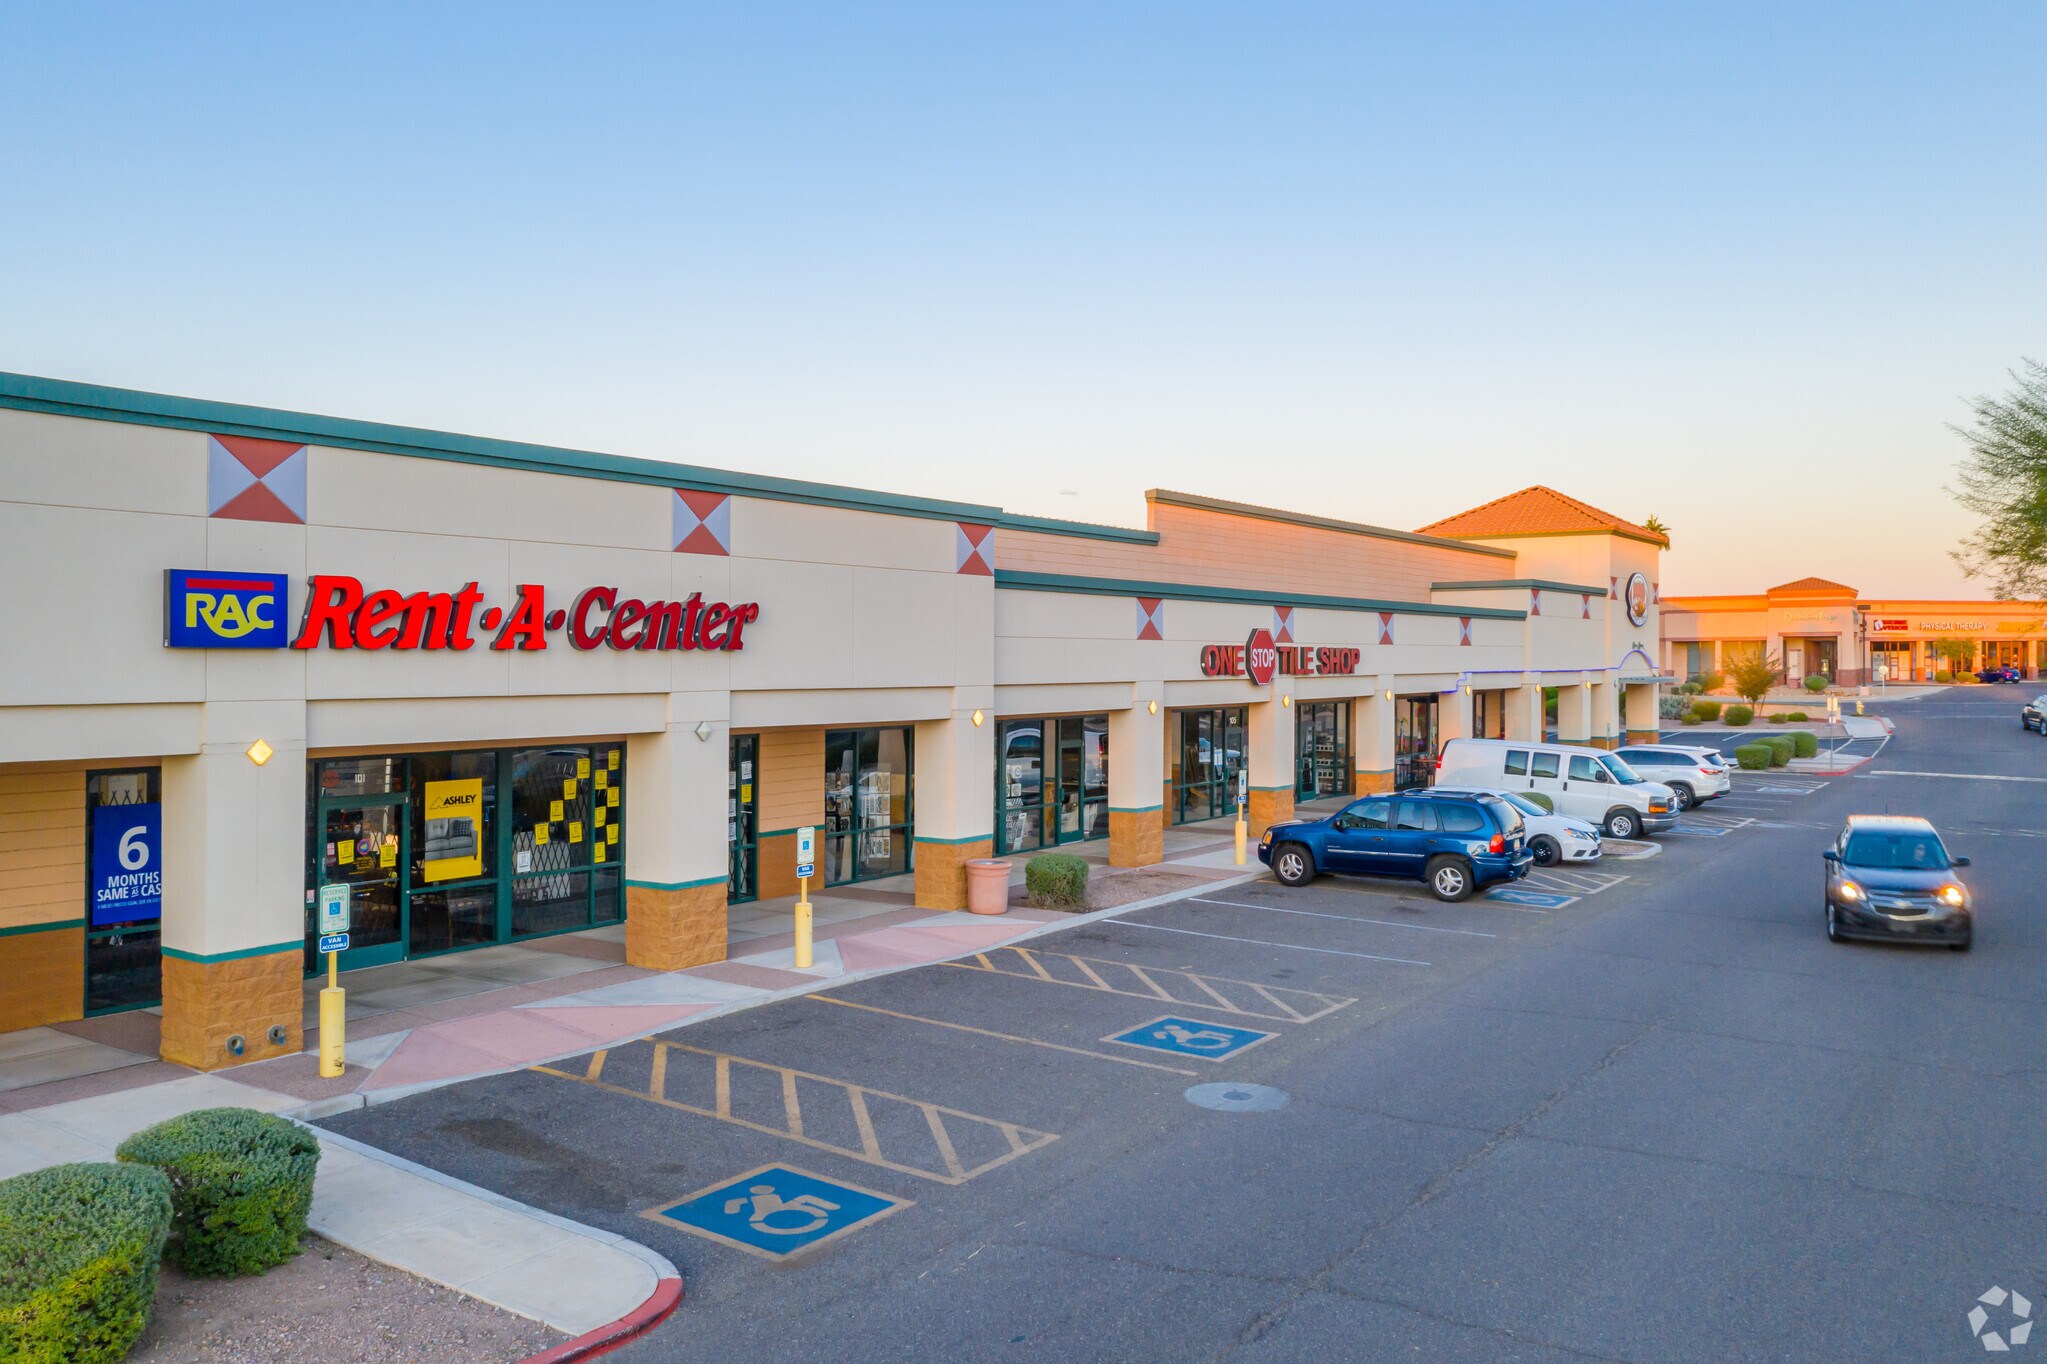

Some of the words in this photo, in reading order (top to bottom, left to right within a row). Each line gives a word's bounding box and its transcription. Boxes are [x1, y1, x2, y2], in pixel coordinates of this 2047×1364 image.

[186, 593, 274, 639] RAC
[1920, 622, 1954, 631] PHYSICAL
[1956, 622, 1987, 631] THERAPY
[1202, 645, 1245, 676] ONE
[1252, 648, 1275, 668] STOP
[1277, 646, 1314, 675] TILE
[1317, 647, 1361, 675] SHOP
[1229, 716, 1237, 725] 105
[354, 773, 366, 783] 101
[443, 794, 477, 806] ASHLEY
[118, 825, 149, 871] 6
[108, 871, 159, 888] MONTHS
[97, 887, 129, 902] SAME
[131, 886, 139, 897] AS
[141, 883, 162, 895] CAS
[323, 887, 347, 896] RESERVED
[328, 936, 342, 944] VAN
[322, 942, 347, 950] ACCESSIBLE
